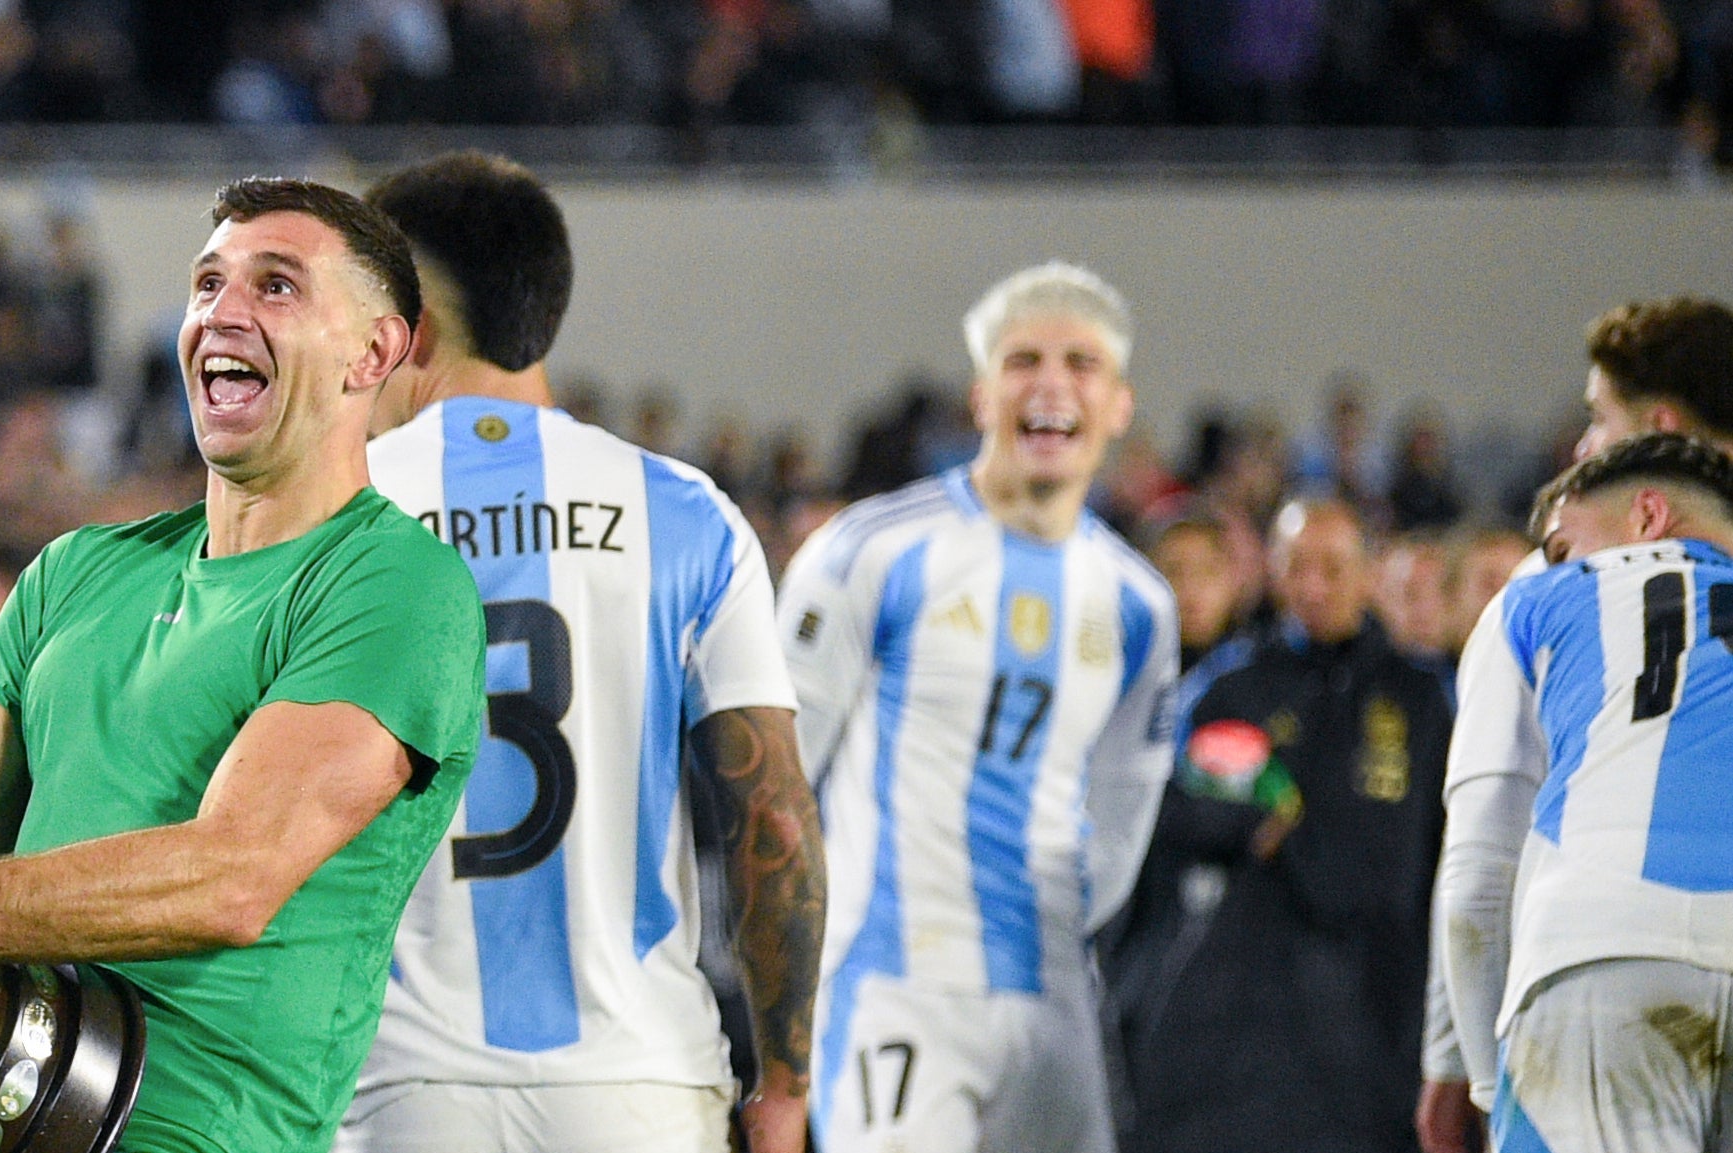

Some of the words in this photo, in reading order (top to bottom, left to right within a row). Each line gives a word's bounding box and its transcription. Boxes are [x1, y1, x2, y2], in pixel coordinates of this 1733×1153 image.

[451, 598, 577, 880] 3
[979, 674, 1054, 761] 17
[858, 1041, 915, 1128] 17
